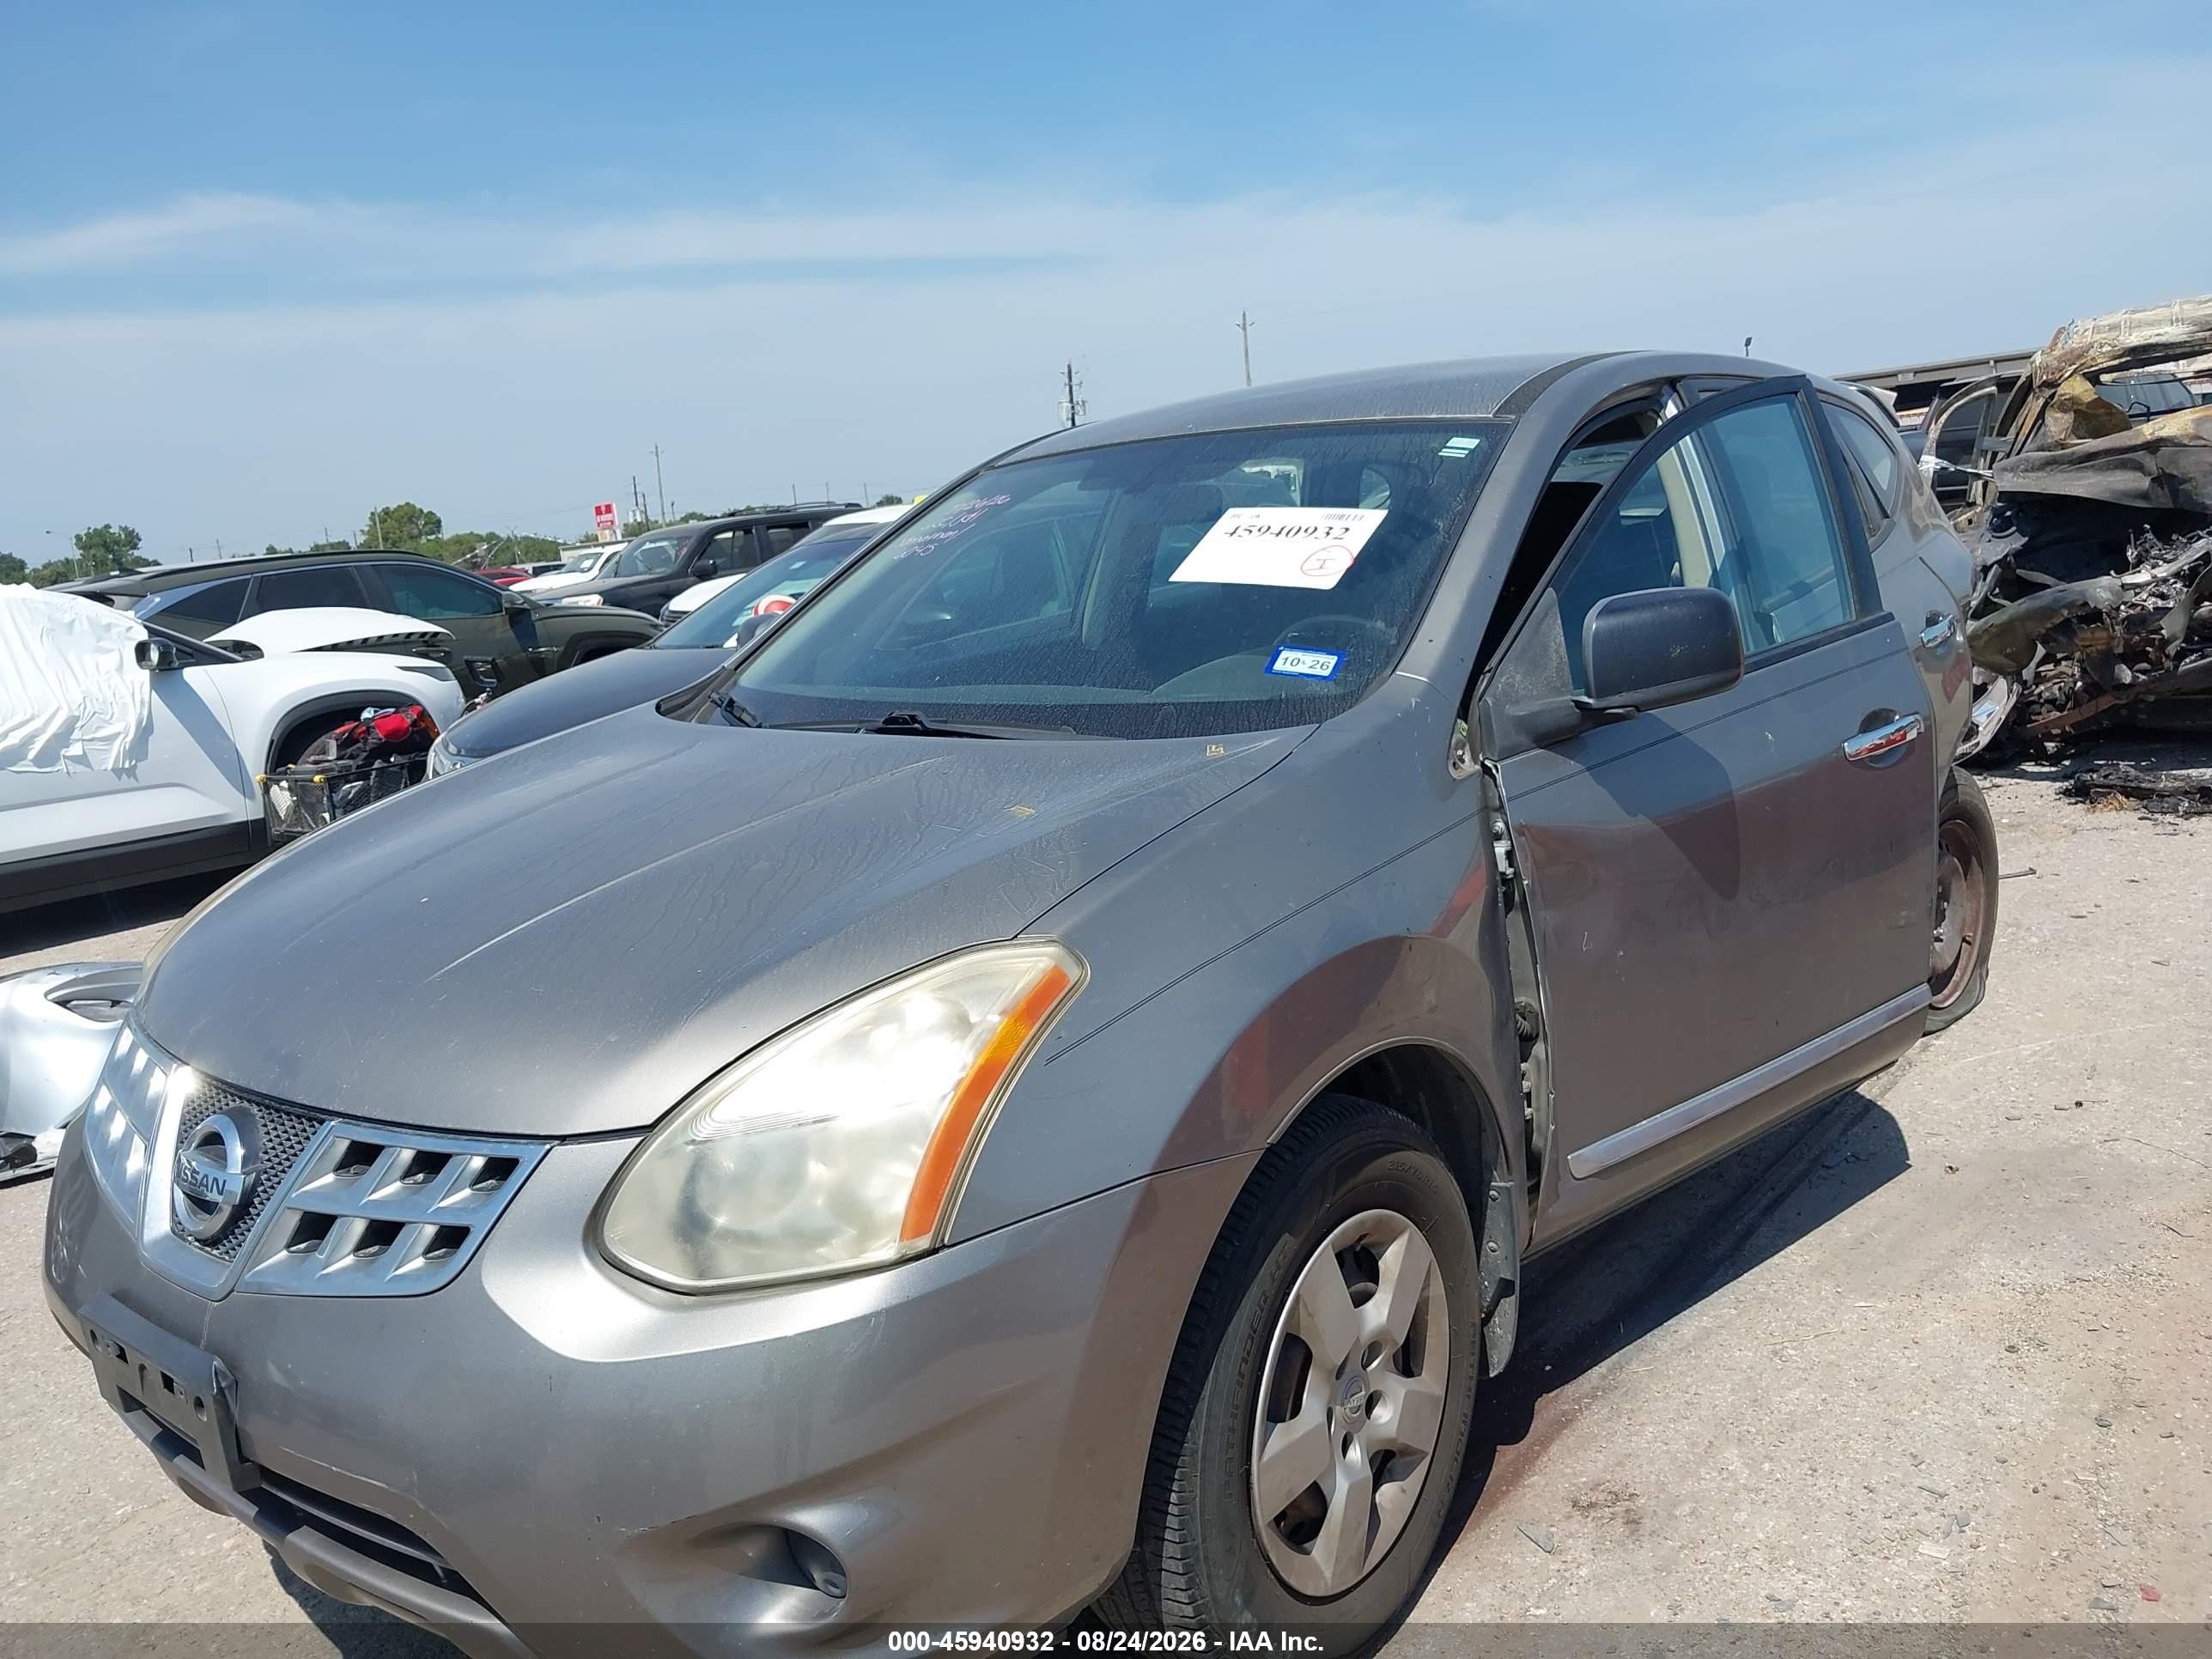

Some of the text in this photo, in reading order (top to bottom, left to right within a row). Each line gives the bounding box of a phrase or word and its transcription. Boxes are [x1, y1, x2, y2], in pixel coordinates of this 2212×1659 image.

[1224, 525, 1351, 541] 45940932
[1281, 656, 1332, 672] 10 26
